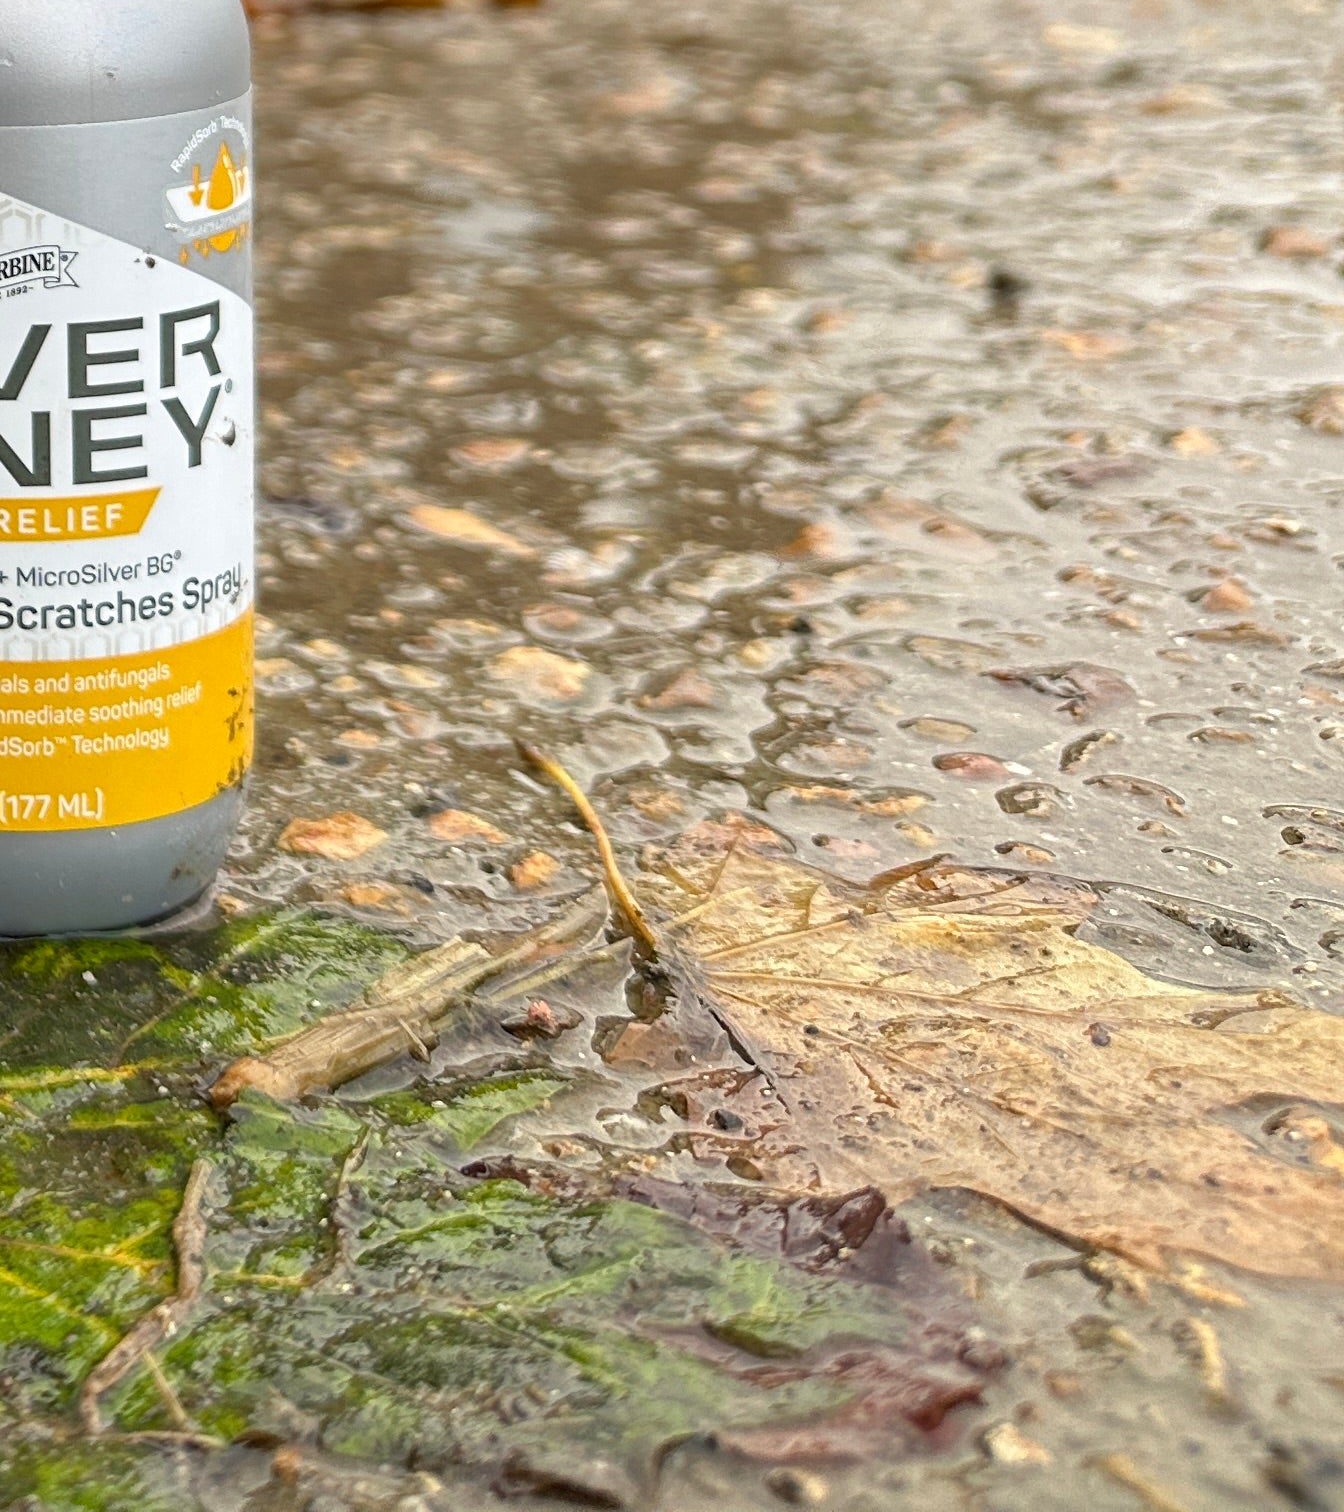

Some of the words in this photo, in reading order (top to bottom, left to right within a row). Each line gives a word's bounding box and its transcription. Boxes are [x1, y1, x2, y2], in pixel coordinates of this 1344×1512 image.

[15, 562, 142, 588] MicroSilver
[181, 561, 242, 613] Spray
[33, 672, 70, 695] and
[73, 660, 171, 691] antifungals
[88, 693, 164, 723] soothing
[165, 679, 203, 710] relief
[70, 726, 171, 757] Technology
[57, 786, 105, 821] ML)
